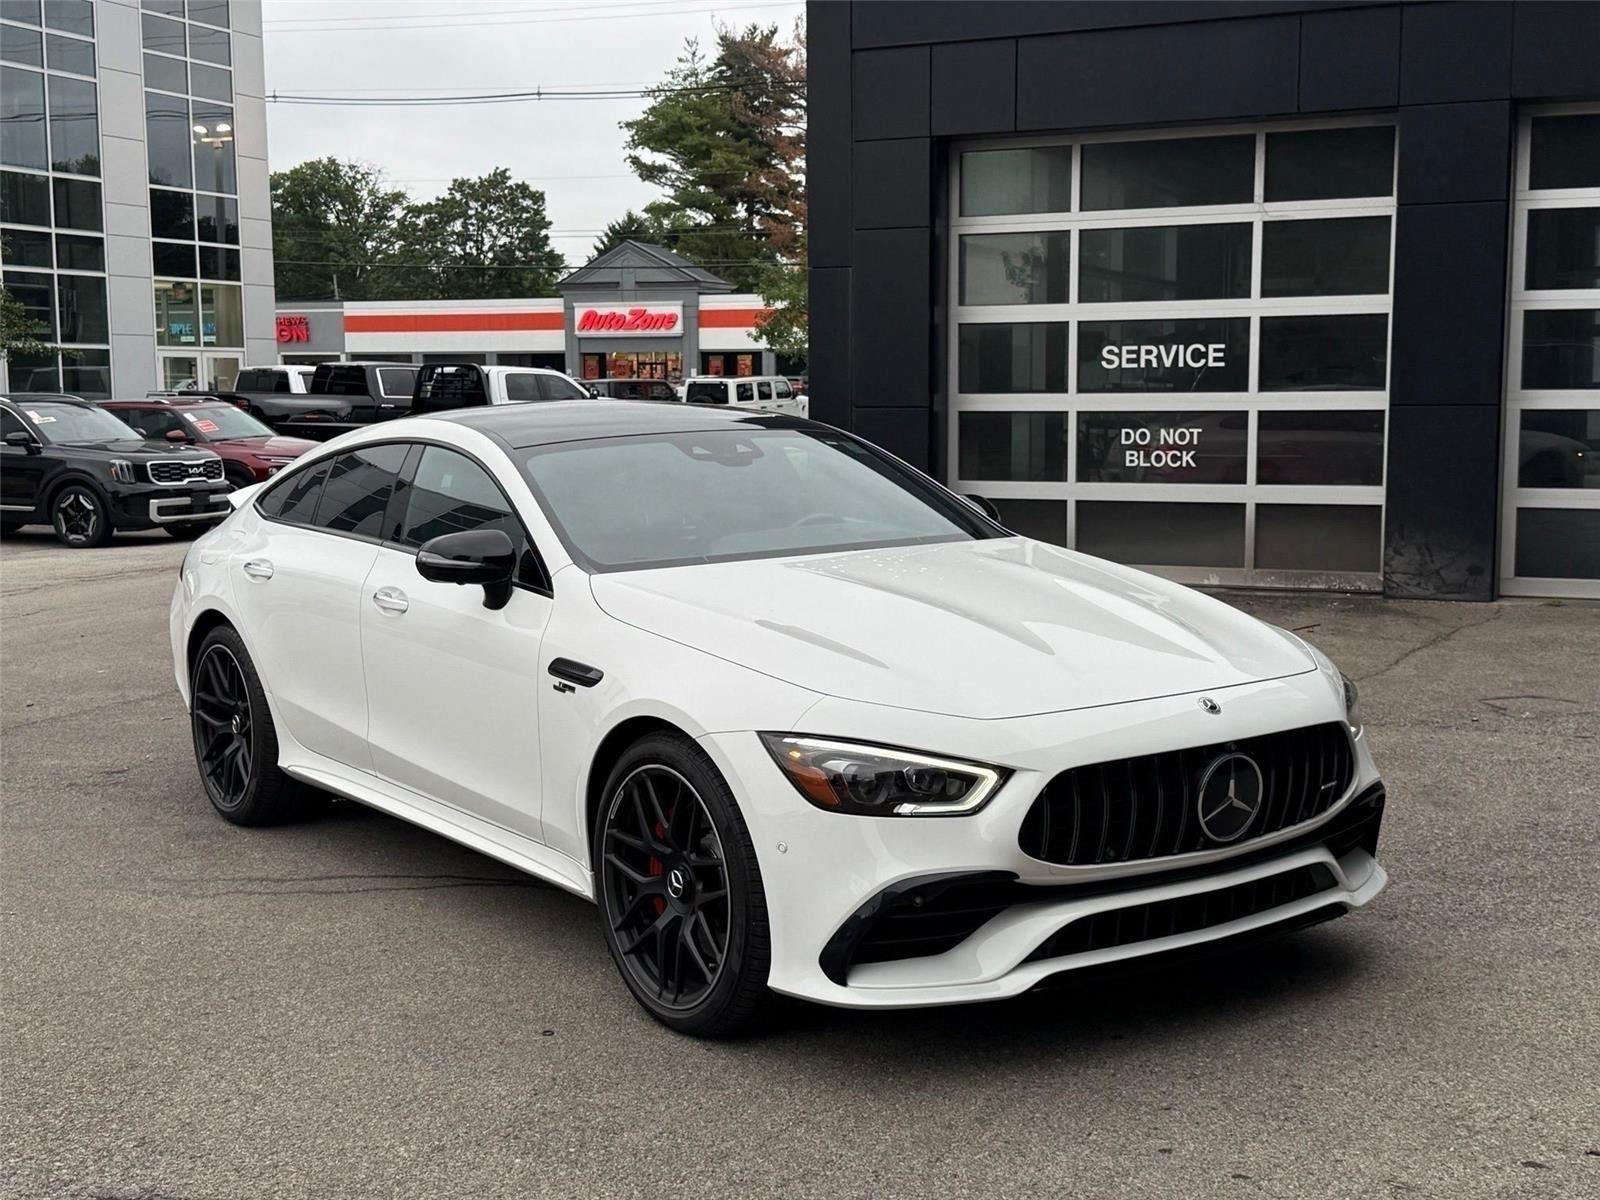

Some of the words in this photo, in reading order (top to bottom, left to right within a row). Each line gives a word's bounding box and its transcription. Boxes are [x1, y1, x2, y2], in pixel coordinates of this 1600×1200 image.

[577, 309, 679, 331] AutoZone
[1101, 343, 1226, 369] SERVICE
[1120, 428, 1151, 445] DO
[1160, 428, 1203, 445] NOT
[1125, 450, 1197, 467] BLOCK
